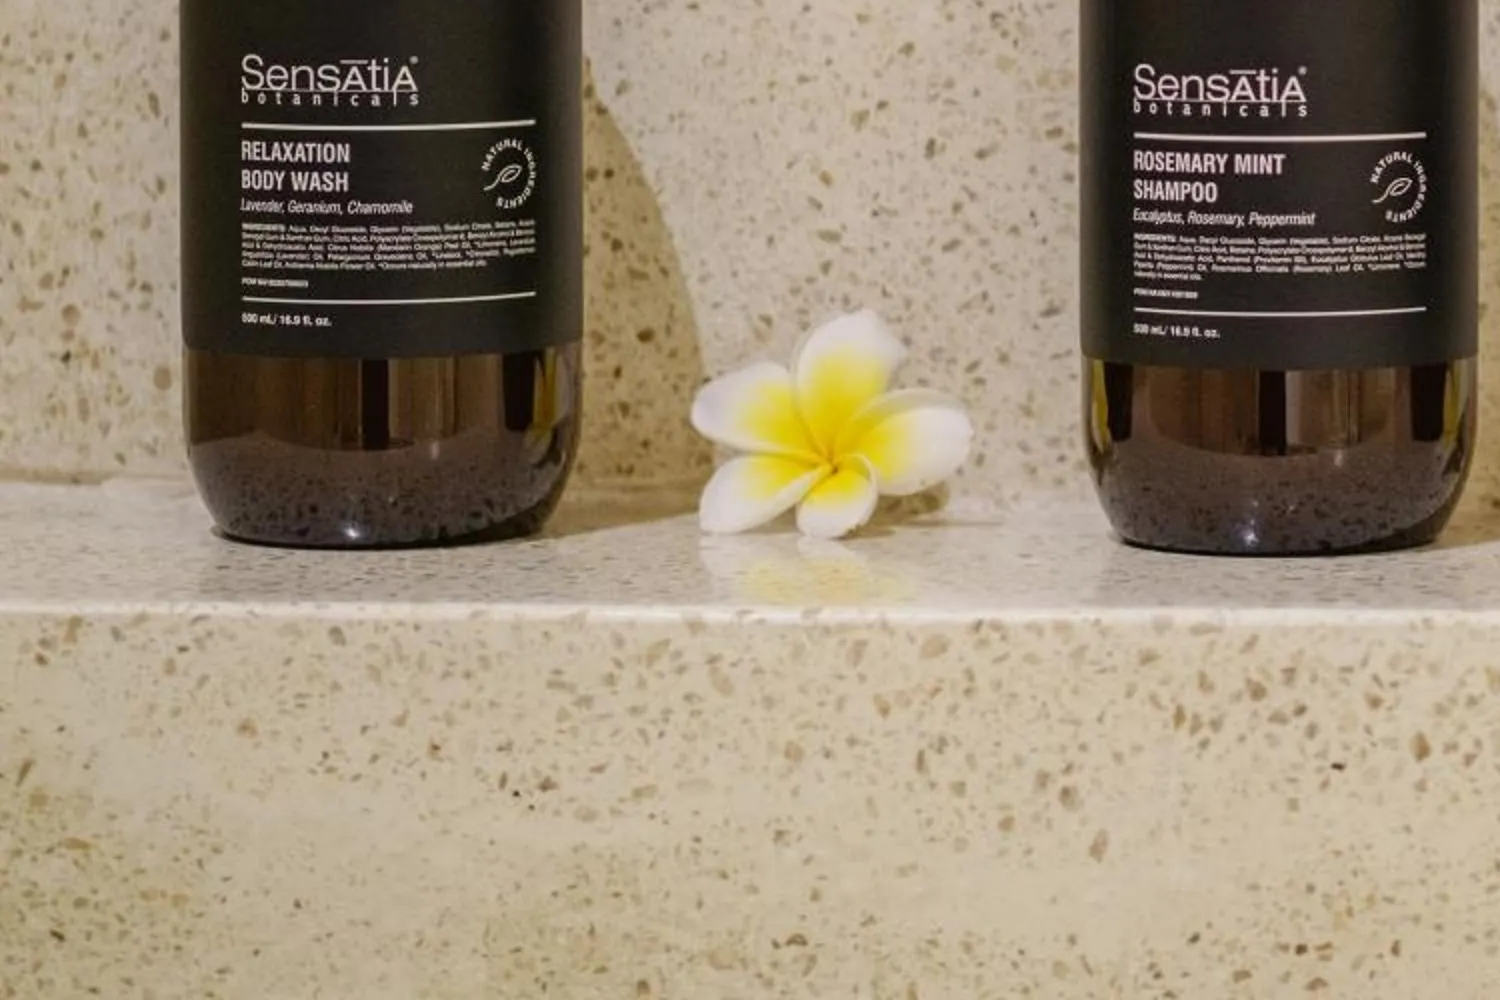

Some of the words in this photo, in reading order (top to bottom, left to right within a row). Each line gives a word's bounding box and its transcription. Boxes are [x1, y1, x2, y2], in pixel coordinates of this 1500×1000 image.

[242, 89, 418, 106] botanicals
[1134, 98, 1307, 117] botanicals
[242, 141, 350, 163] RELAXATION
[481, 138, 522, 171] NATURAL
[1134, 150, 1228, 174] ROSEMARY
[1234, 154, 1286, 174] MINT
[496, 147, 537, 209] INGREDIENTS
[1370, 151, 1413, 184] NATURAL
[242, 172, 284, 191] BODY
[291, 172, 348, 192] WASH
[1134, 180, 1218, 203] SHAMPOO
[1385, 160, 1427, 223] INGREDIENTS
[288, 200, 342, 215] Geranium,
[348, 200, 413, 214] Chamomile
[1188, 210, 1244, 228] Rosemary,
[1248, 212, 1316, 228] Peppermint
